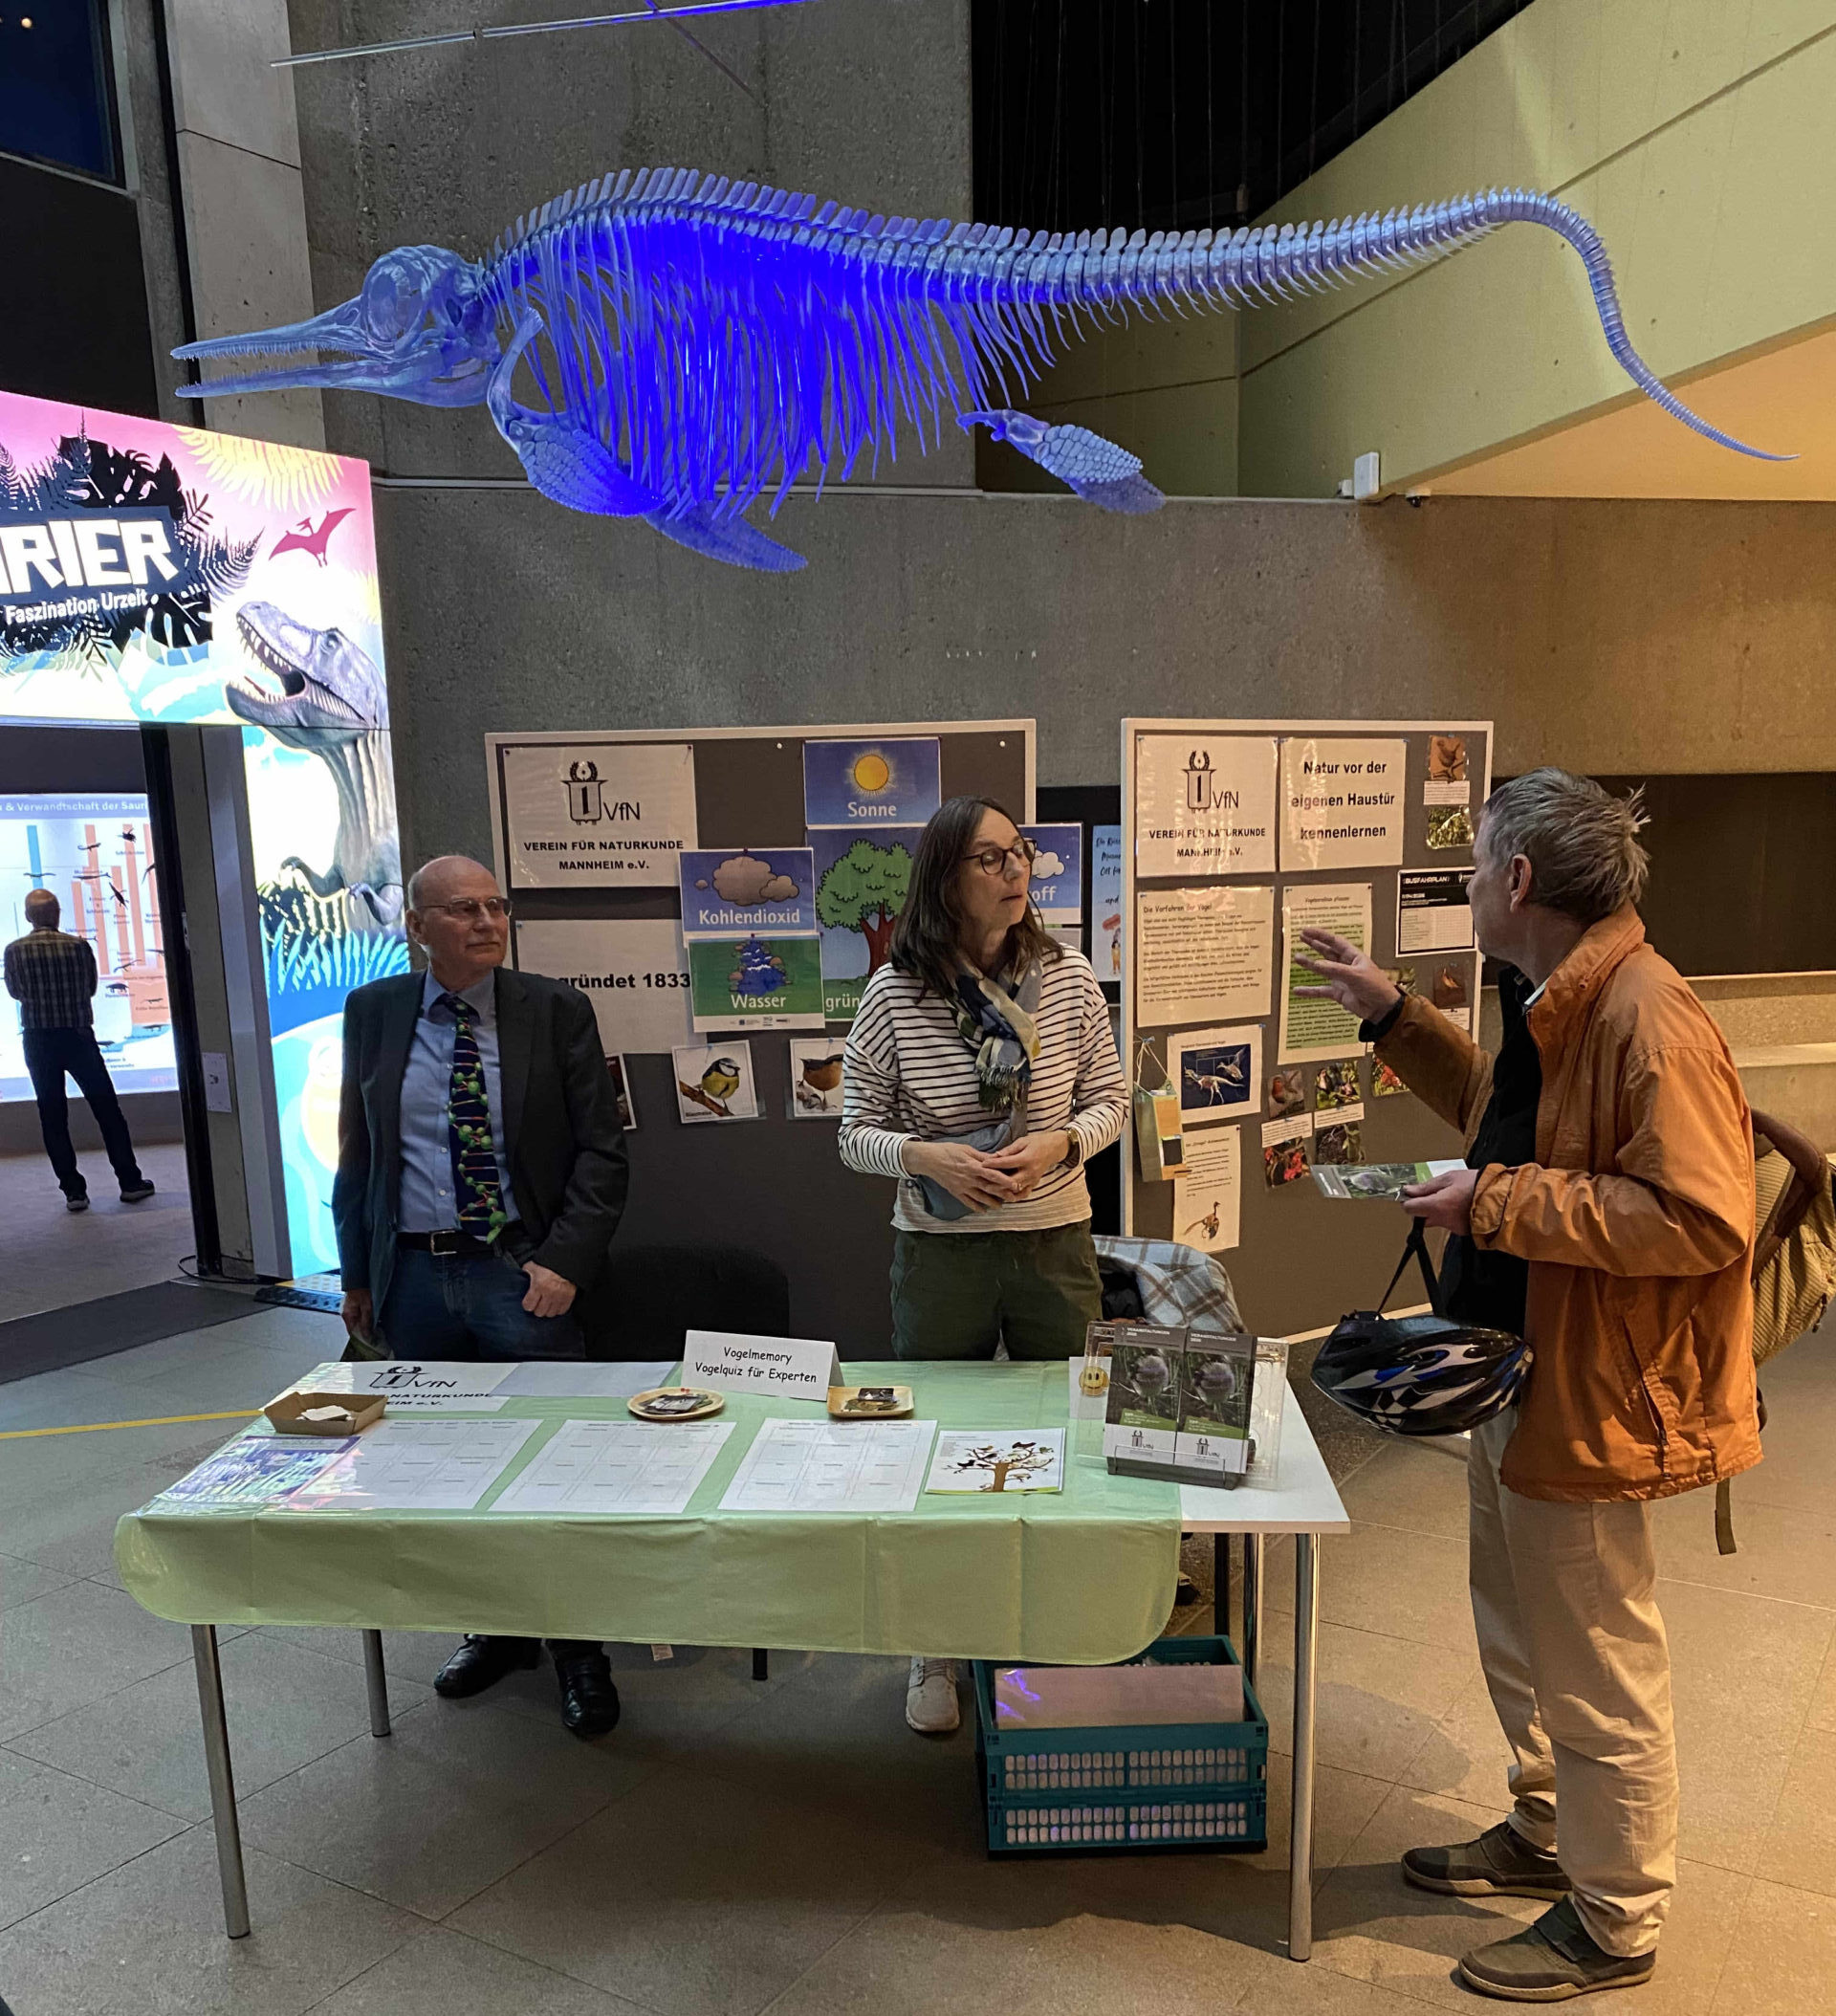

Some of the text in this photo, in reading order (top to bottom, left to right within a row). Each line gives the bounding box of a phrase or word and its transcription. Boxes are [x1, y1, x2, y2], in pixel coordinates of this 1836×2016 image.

[0, 519, 179, 594] RIER
[5, 588, 148, 625] Faszination Urzeit
[1303, 760, 1388, 775] Natur vor der
[6, 803, 14, 812] &
[17, 801, 100, 812] Verwandtschaft
[102, 801, 119, 811] der
[1213, 791, 1239, 809] VfN
[1291, 792, 1395, 810] eigenen Haustür
[603, 801, 641, 821] VfN
[848, 802, 897, 818] Sonne
[1149, 829, 1184, 839] VEREIN
[1187, 827, 1205, 838] FÜR
[1300, 825, 1387, 840] kennenlernen
[524, 840, 684, 851] VEREIN FÜR NATURKUNDE
[558, 860, 649, 869] MANNHEIM e.V.
[1029, 886, 1057, 901] off
[699, 909, 800, 925] Kohlendioxid
[643, 974, 690, 988] 1833
[731, 995, 786, 1009] Wasser
[723, 1347, 793, 1365] Vogelmemory
[695, 1361, 817, 1383] Vogelquiz für Experten
